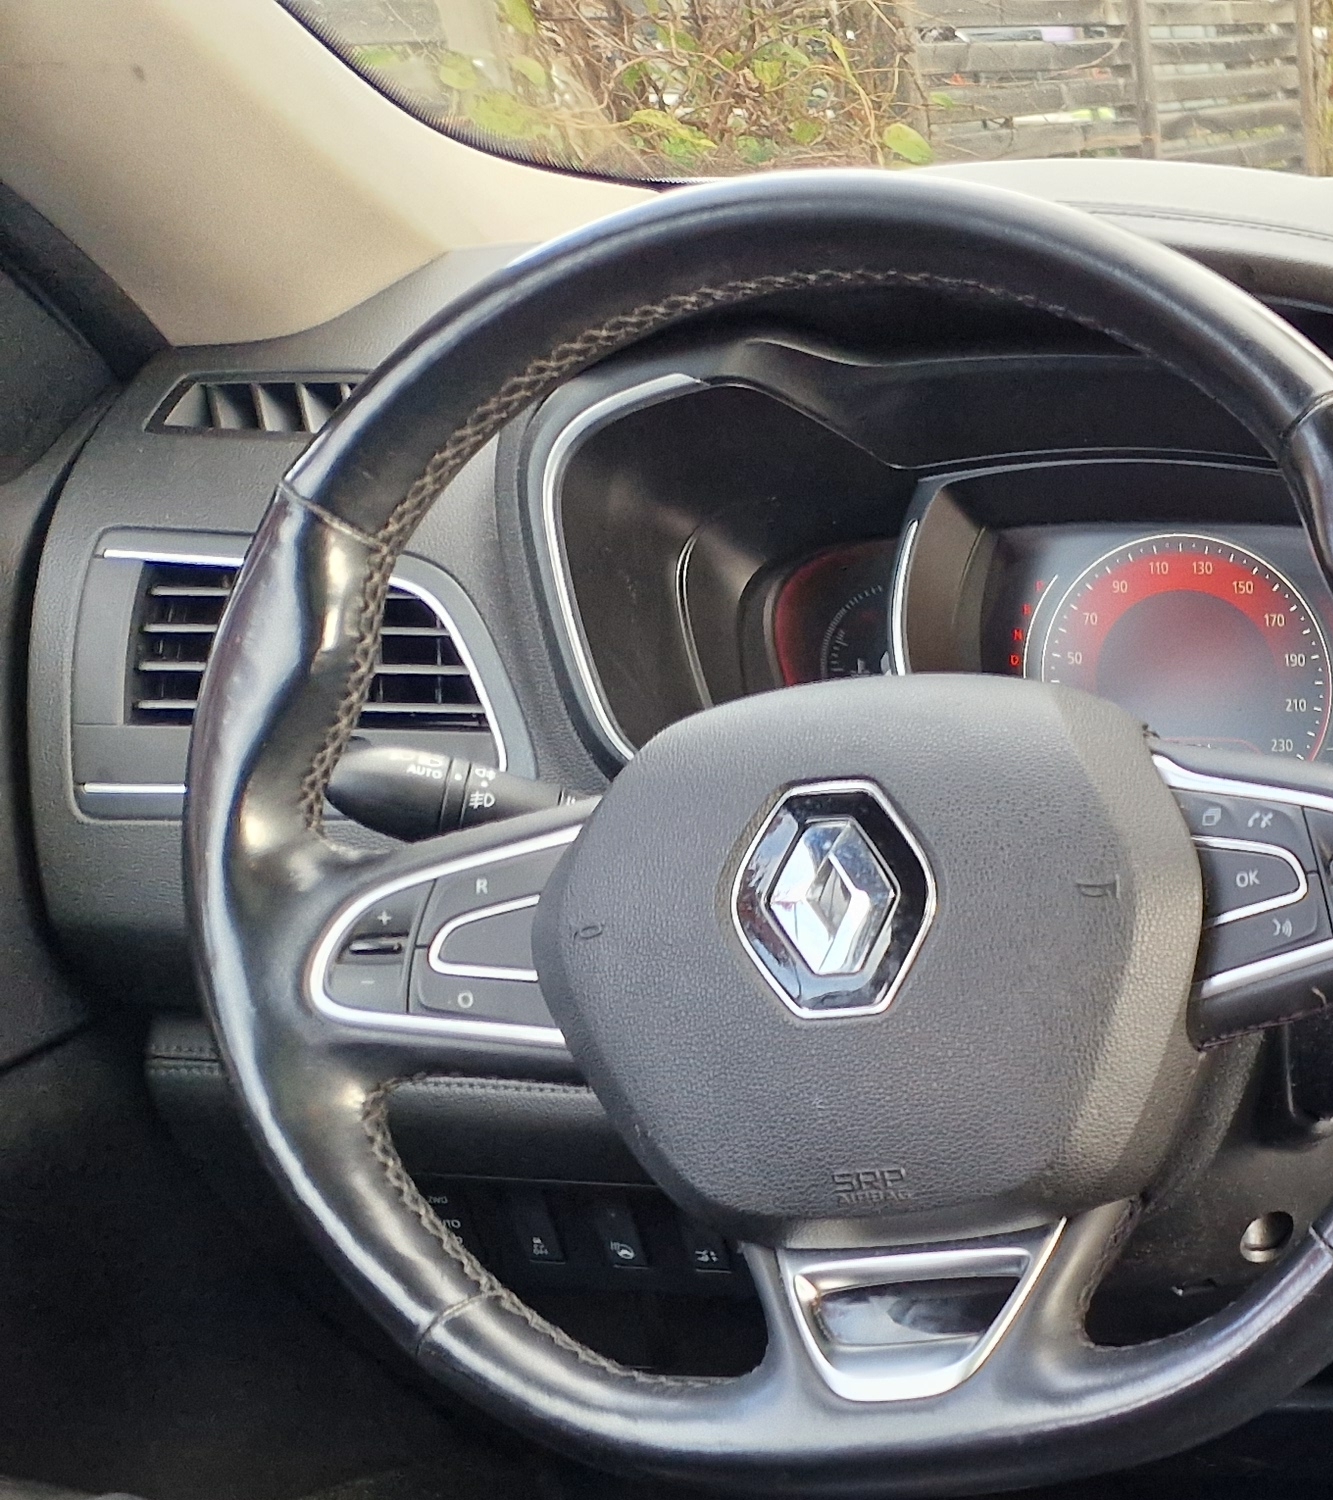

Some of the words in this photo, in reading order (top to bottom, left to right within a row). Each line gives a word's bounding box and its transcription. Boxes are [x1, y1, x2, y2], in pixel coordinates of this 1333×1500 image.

[1149, 562, 1169, 574] 110
[1192, 561, 1213, 575] 130
[1112, 580, 1128, 593] 90
[1233, 580, 1254, 594] 150
[1083, 612, 1098, 625] 70
[1264, 613, 1285, 627] 170
[1067, 651, 1082, 665] 50
[1285, 653, 1306, 667] 190
[1285, 698, 1307, 712] 210
[1271, 738, 1293, 752] 230
[406, 764, 443, 779] AUTO
[475, 878, 488, 894] R
[1235, 870, 1261, 888] OK
[832, 1167, 905, 1192] SRP
